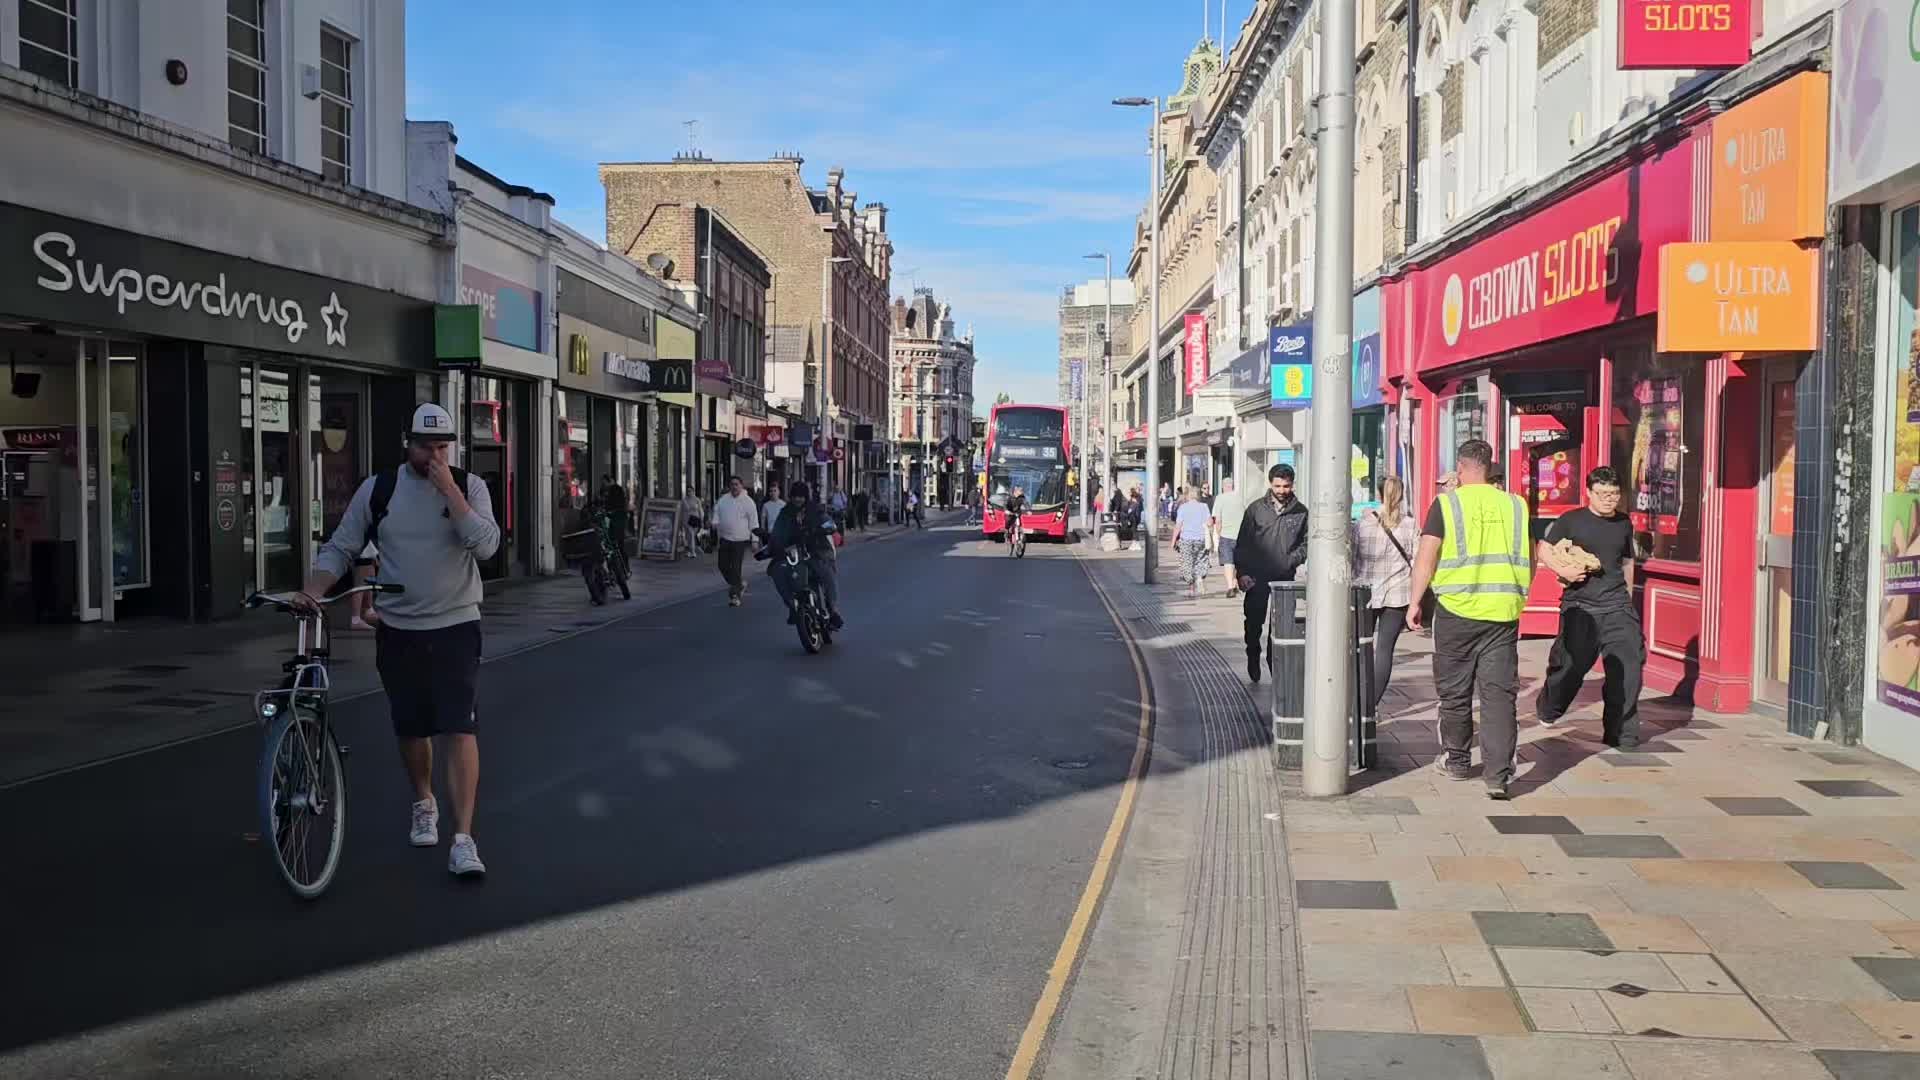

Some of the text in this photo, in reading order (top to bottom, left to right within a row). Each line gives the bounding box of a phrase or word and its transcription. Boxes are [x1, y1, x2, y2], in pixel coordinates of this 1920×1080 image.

[1645, 4, 1730, 31] SLOTS
[1739, 128, 1786, 174] ULTRA
[1739, 185, 1767, 225] TAN
[33, 231, 308, 343] Superdrug
[1468, 216, 1621, 330] CROWN SLOTS
[1714, 261, 1792, 295] ULTRA
[1716, 300, 1760, 337] TAN
[1274, 336, 1305, 353] Boots
[1042, 447, 1055, 457] 35
